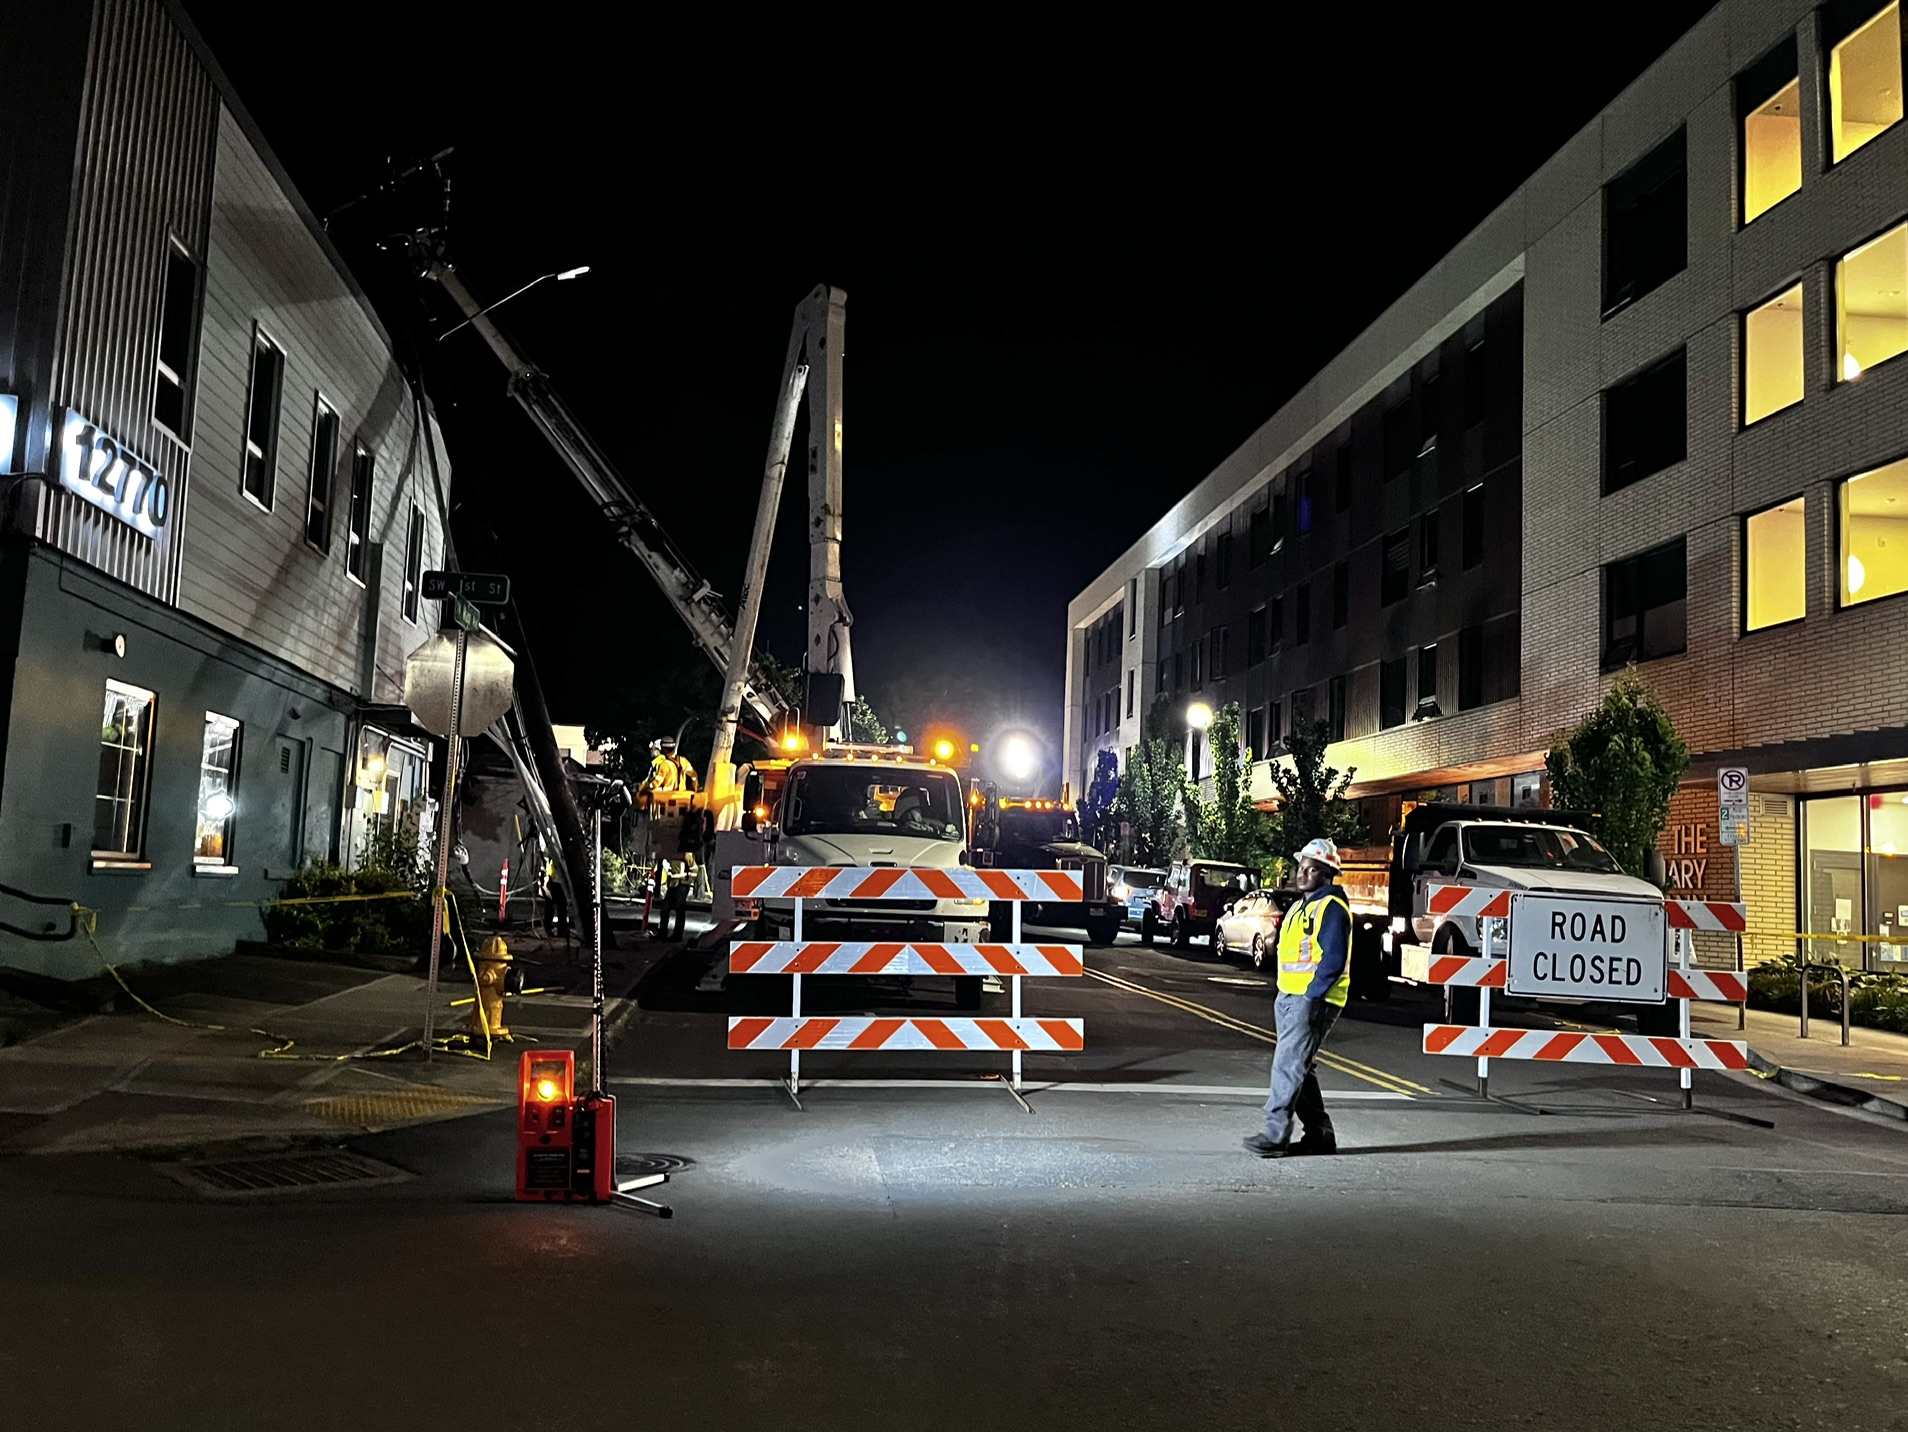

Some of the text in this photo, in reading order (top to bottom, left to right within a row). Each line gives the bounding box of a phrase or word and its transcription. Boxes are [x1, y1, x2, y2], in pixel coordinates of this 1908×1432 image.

[76, 425, 169, 527] 12770
[428, 579, 501, 595] SW 1st St
[1721, 809, 1728, 819] 2
[1672, 824, 1707, 854] THE
[1669, 859, 1707, 889] ARY
[1551, 911, 1626, 944] ROAD
[1533, 951, 1642, 986] CLOSED
